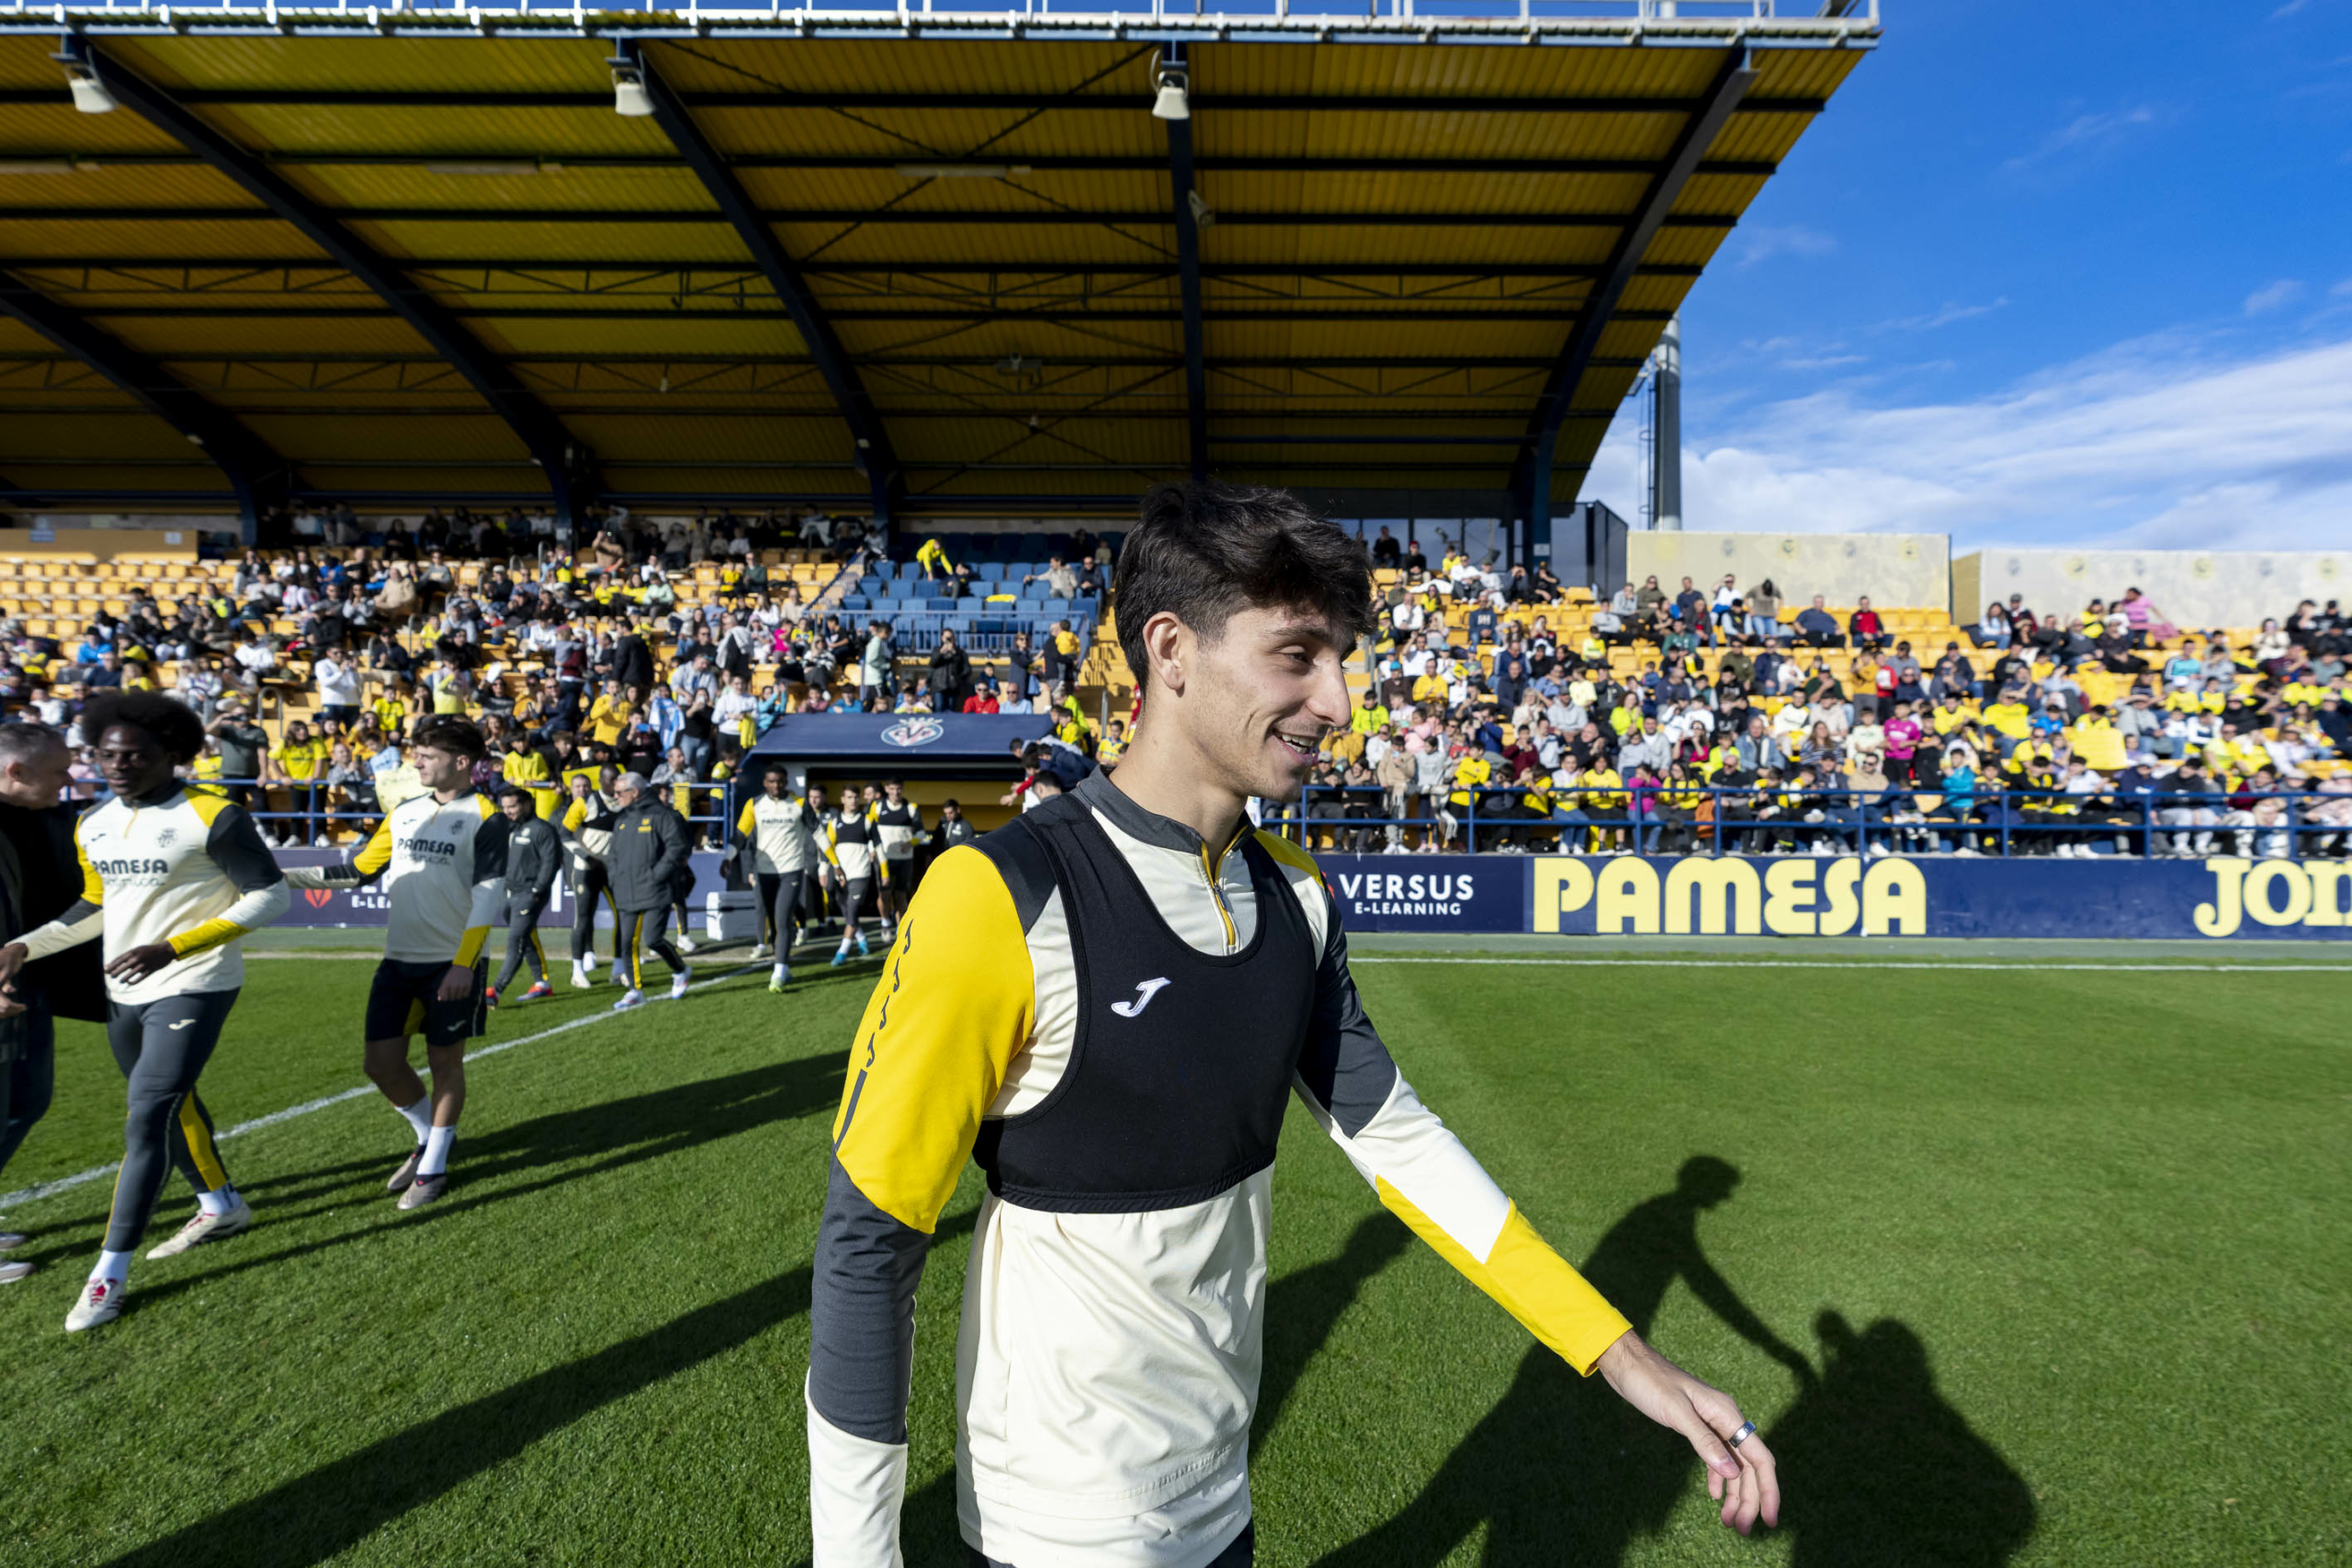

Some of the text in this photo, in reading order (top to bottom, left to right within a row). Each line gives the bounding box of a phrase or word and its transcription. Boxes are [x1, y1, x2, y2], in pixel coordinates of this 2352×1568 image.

[397, 838, 456, 856] PAMESA
[1339, 874, 1474, 901] VERSUS
[1533, 856, 1928, 936] PAMESA
[1354, 902, 1462, 916] E-LEARNING
